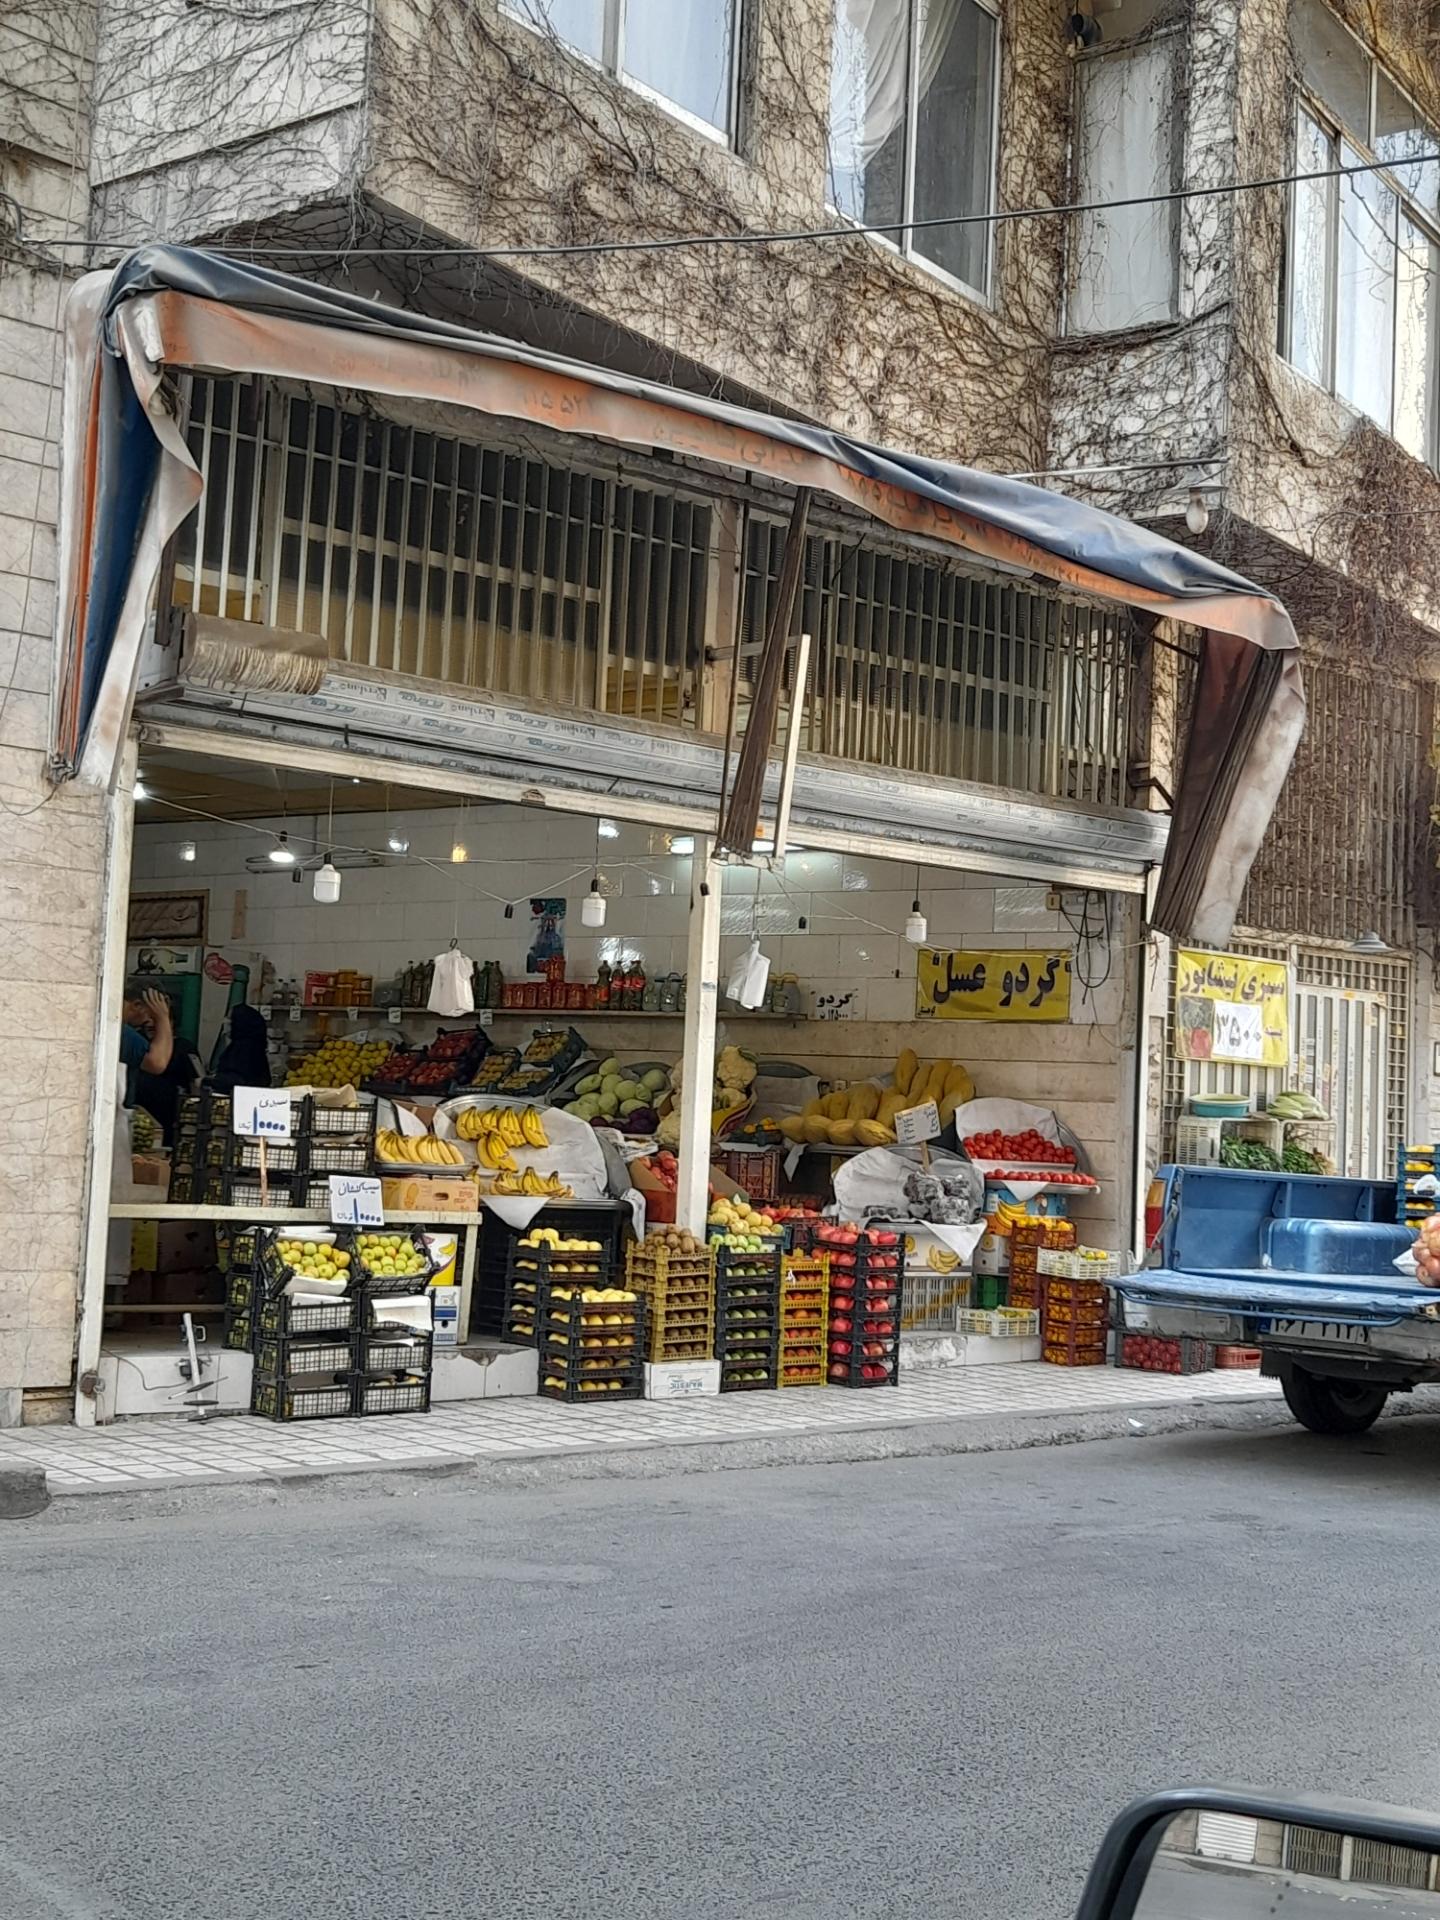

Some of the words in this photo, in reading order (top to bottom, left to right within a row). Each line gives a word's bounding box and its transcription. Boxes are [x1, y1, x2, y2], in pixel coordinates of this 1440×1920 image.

[1180, 959, 1238, 996] نیشابور
[1240, 972, 1285, 1002] سبزی
[253, 1105, 286, 1134] ۱۰۰۰۰
[353, 1197, 382, 1223] ۱۰۰۰۰
